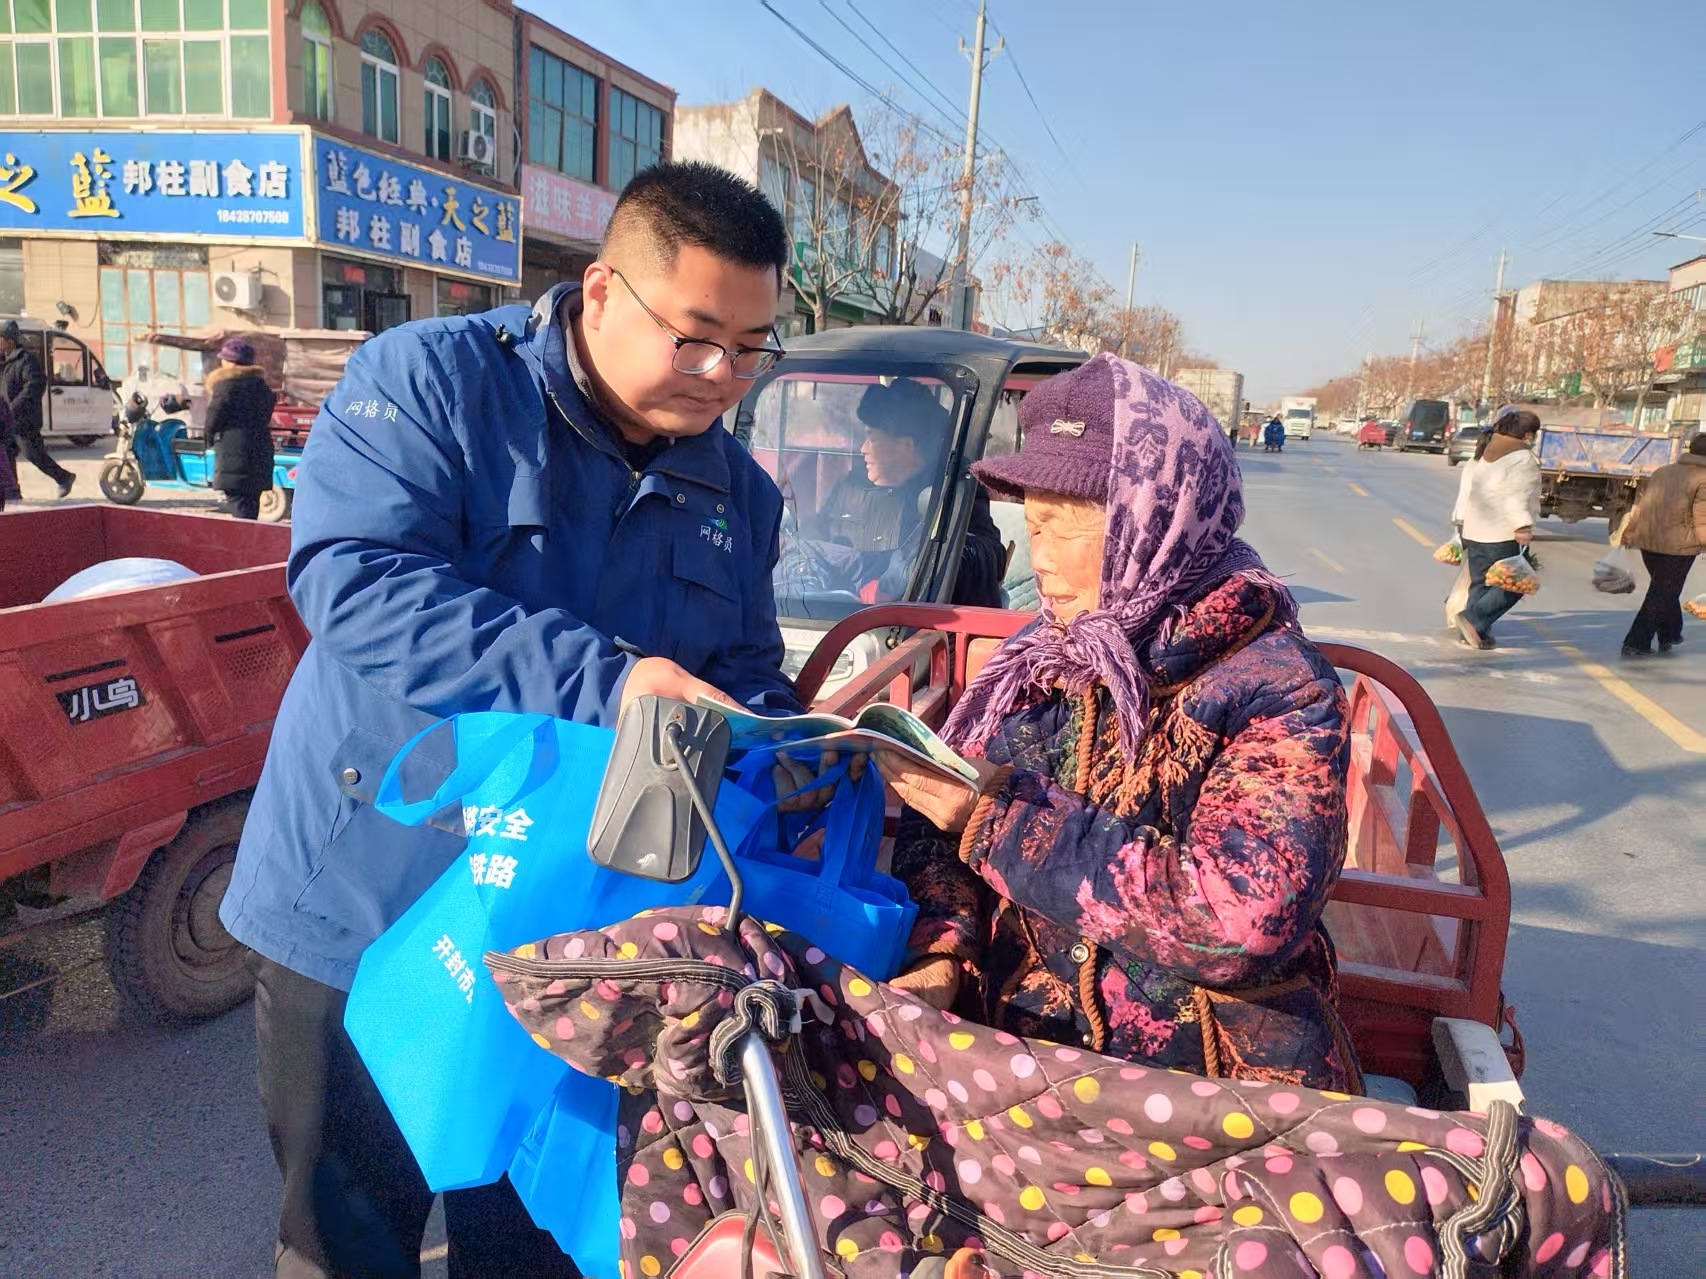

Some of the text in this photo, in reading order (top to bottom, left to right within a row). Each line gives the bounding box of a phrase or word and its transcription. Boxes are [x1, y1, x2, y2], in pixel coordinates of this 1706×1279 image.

[123, 159, 288, 199] 邦柱副食店
[336, 206, 472, 268] 邦柱副食店
[345, 399, 398, 423] 网格员
[700, 525, 733, 553] 网格员
